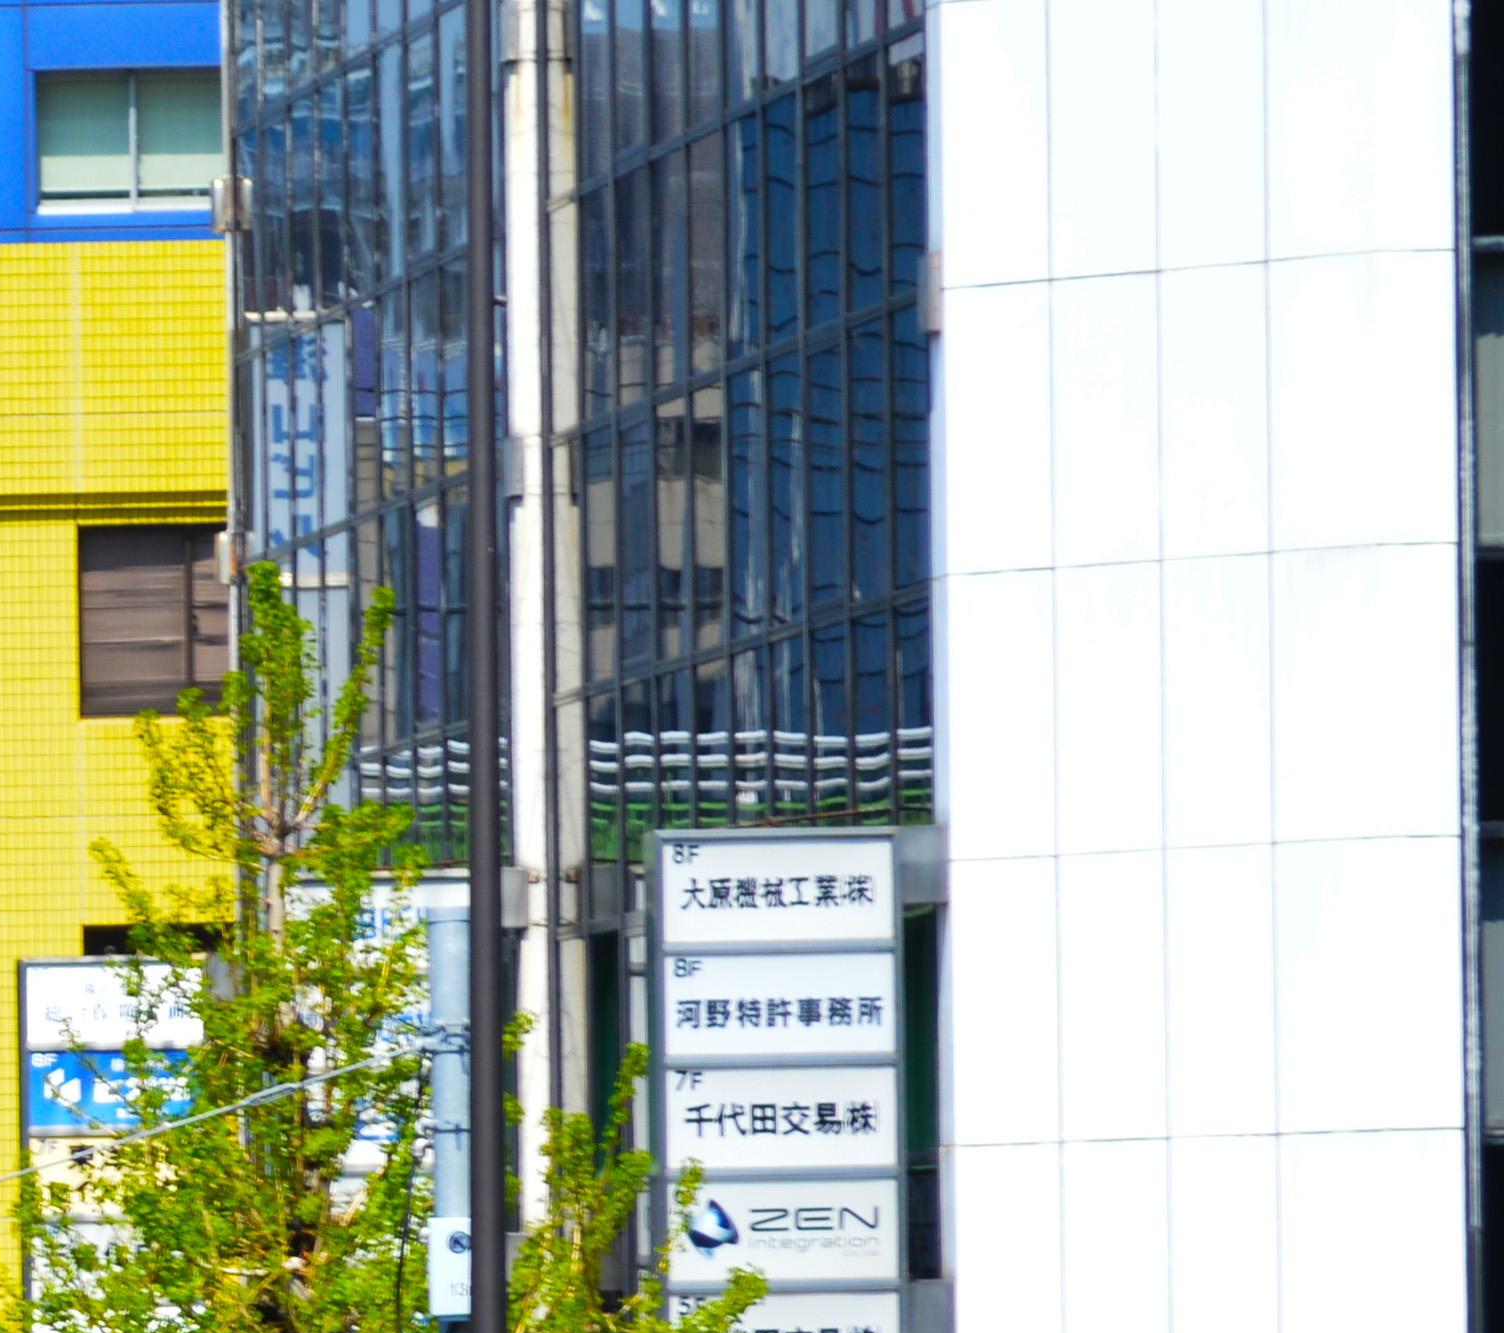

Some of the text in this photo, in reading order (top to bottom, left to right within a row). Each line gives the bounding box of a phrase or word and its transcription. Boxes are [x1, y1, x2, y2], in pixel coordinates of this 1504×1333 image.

[672, 844, 700, 864] 8F
[673, 957, 702, 978] 8F
[676, 996, 883, 1029] 河野特許事務所
[674, 1070, 704, 1091] 7F
[750, 1206, 880, 1231] ZEN
